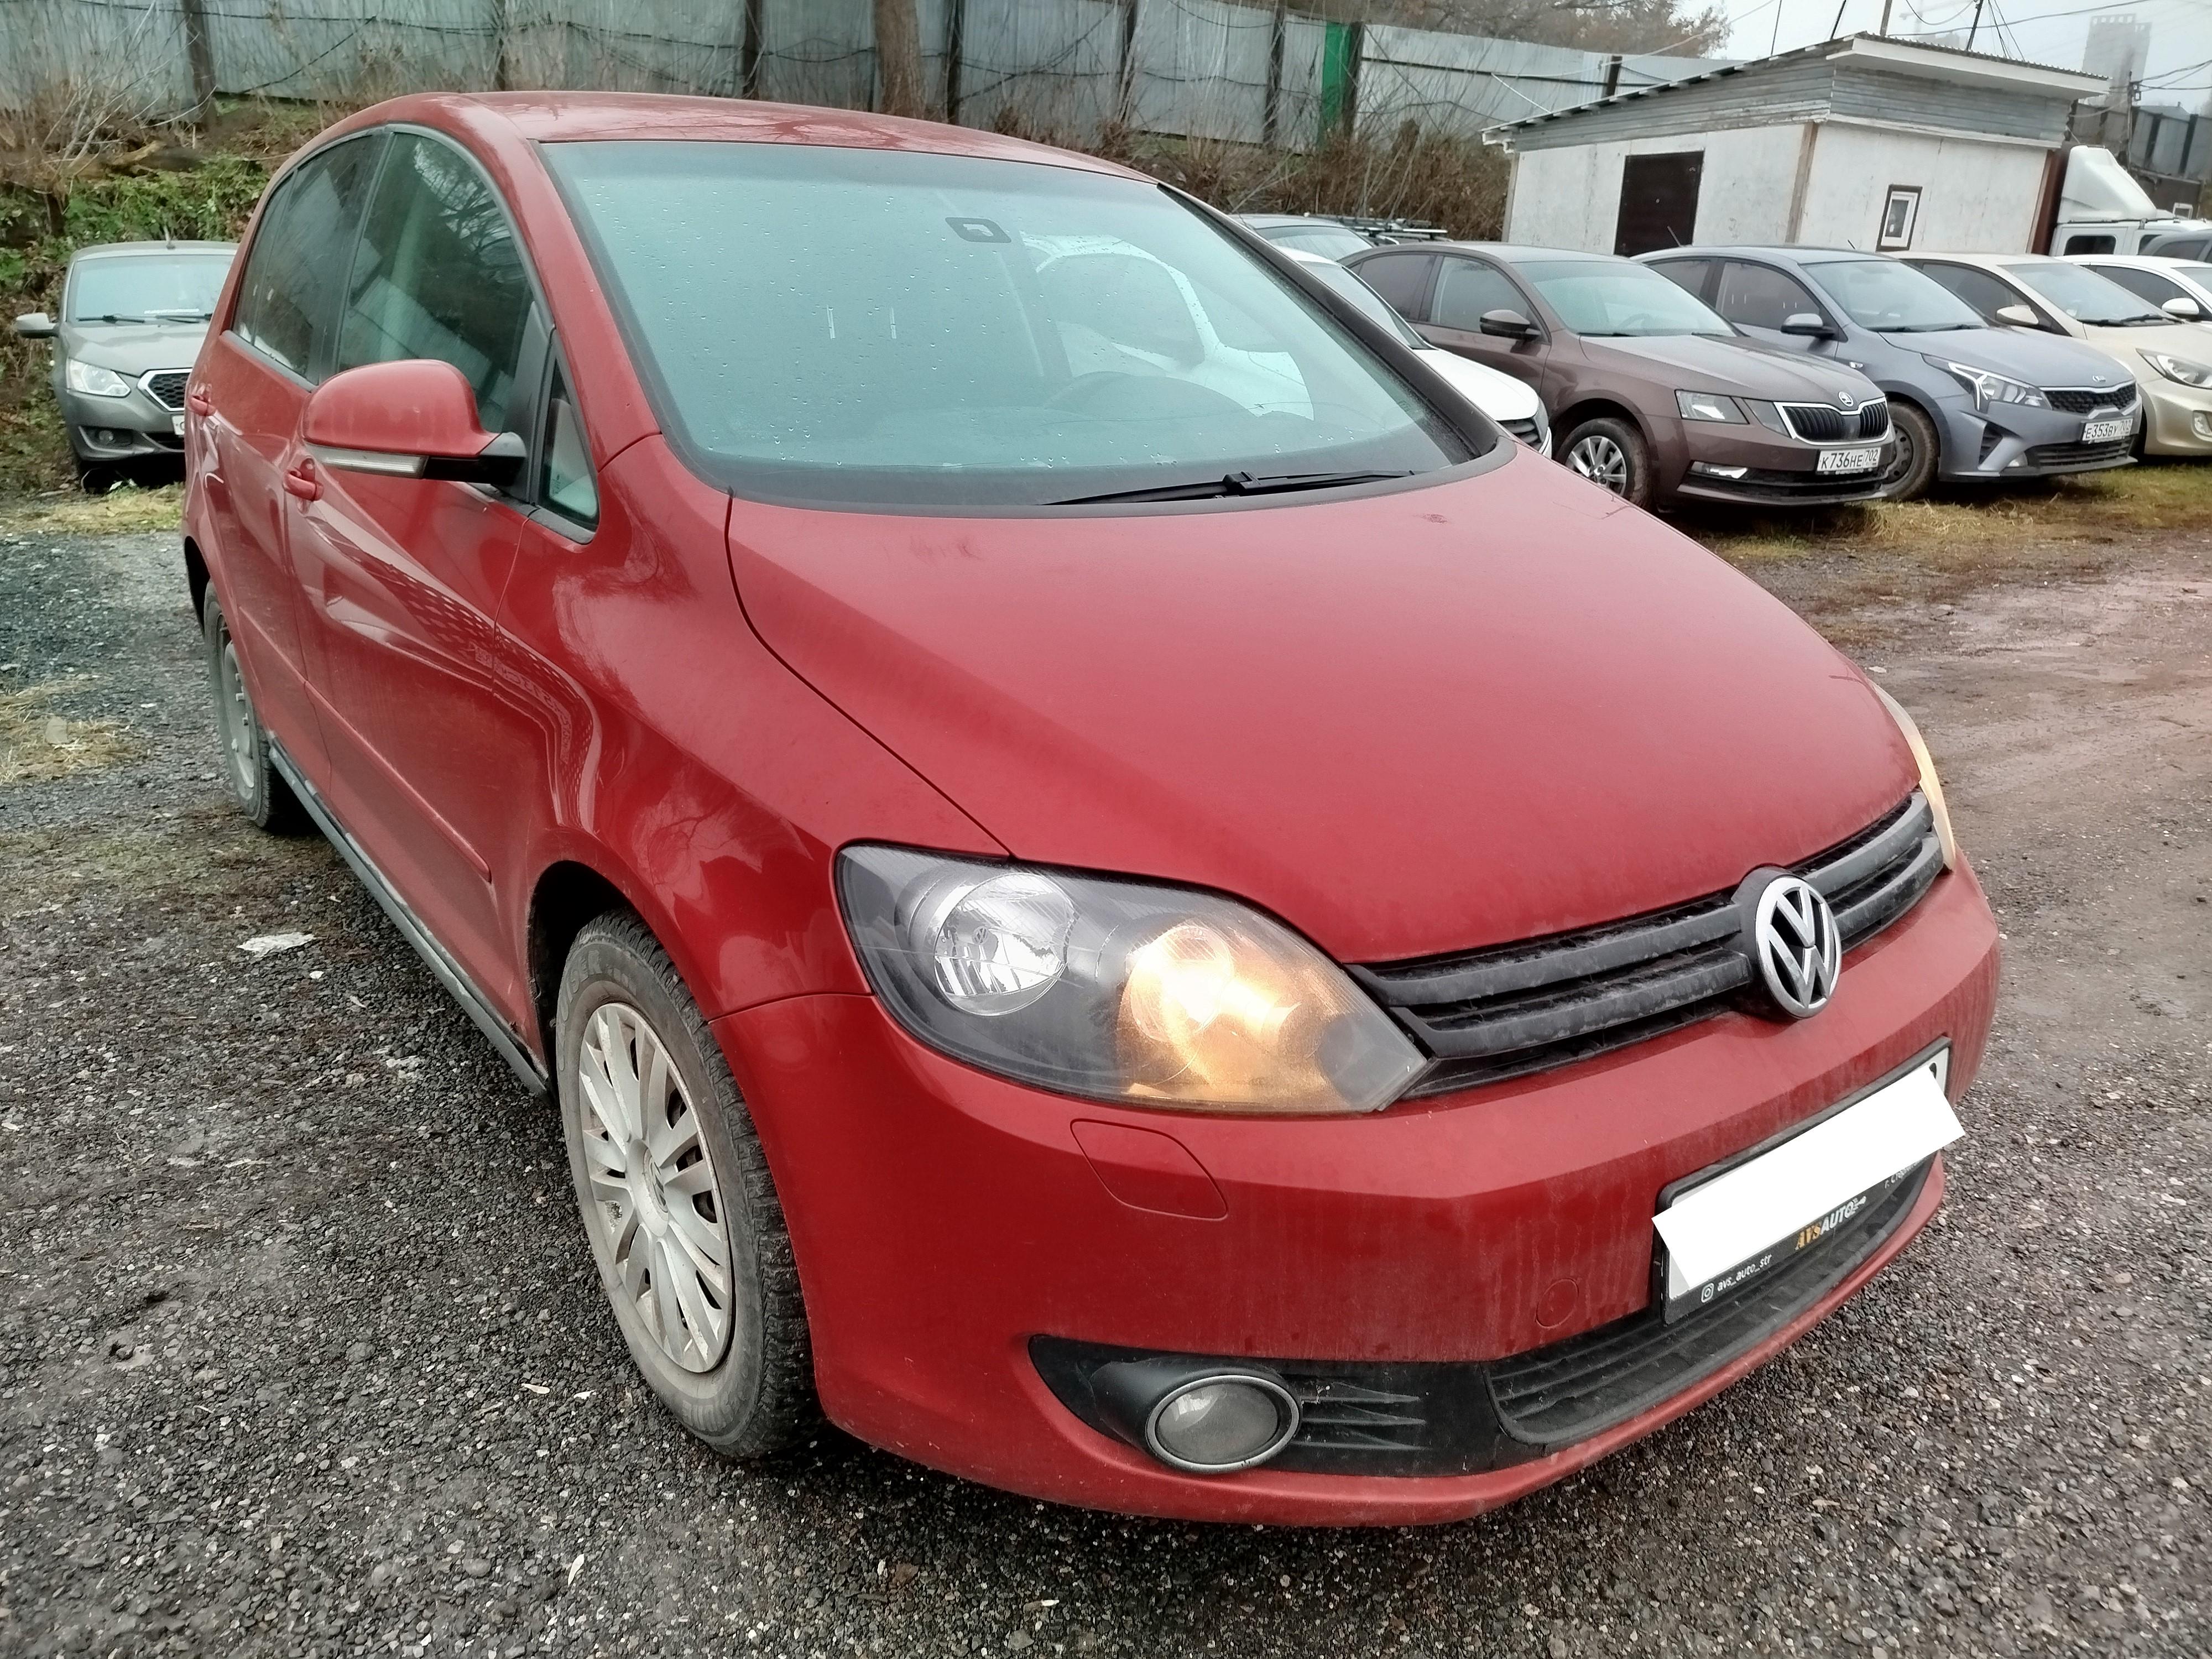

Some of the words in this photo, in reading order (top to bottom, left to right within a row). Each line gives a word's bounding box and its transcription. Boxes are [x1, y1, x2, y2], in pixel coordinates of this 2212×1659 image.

[1821, 452, 1863, 469] К736НЕ
[1865, 449, 1878, 462] 702
[1717, 1254, 1772, 1292] avs_auto_str
